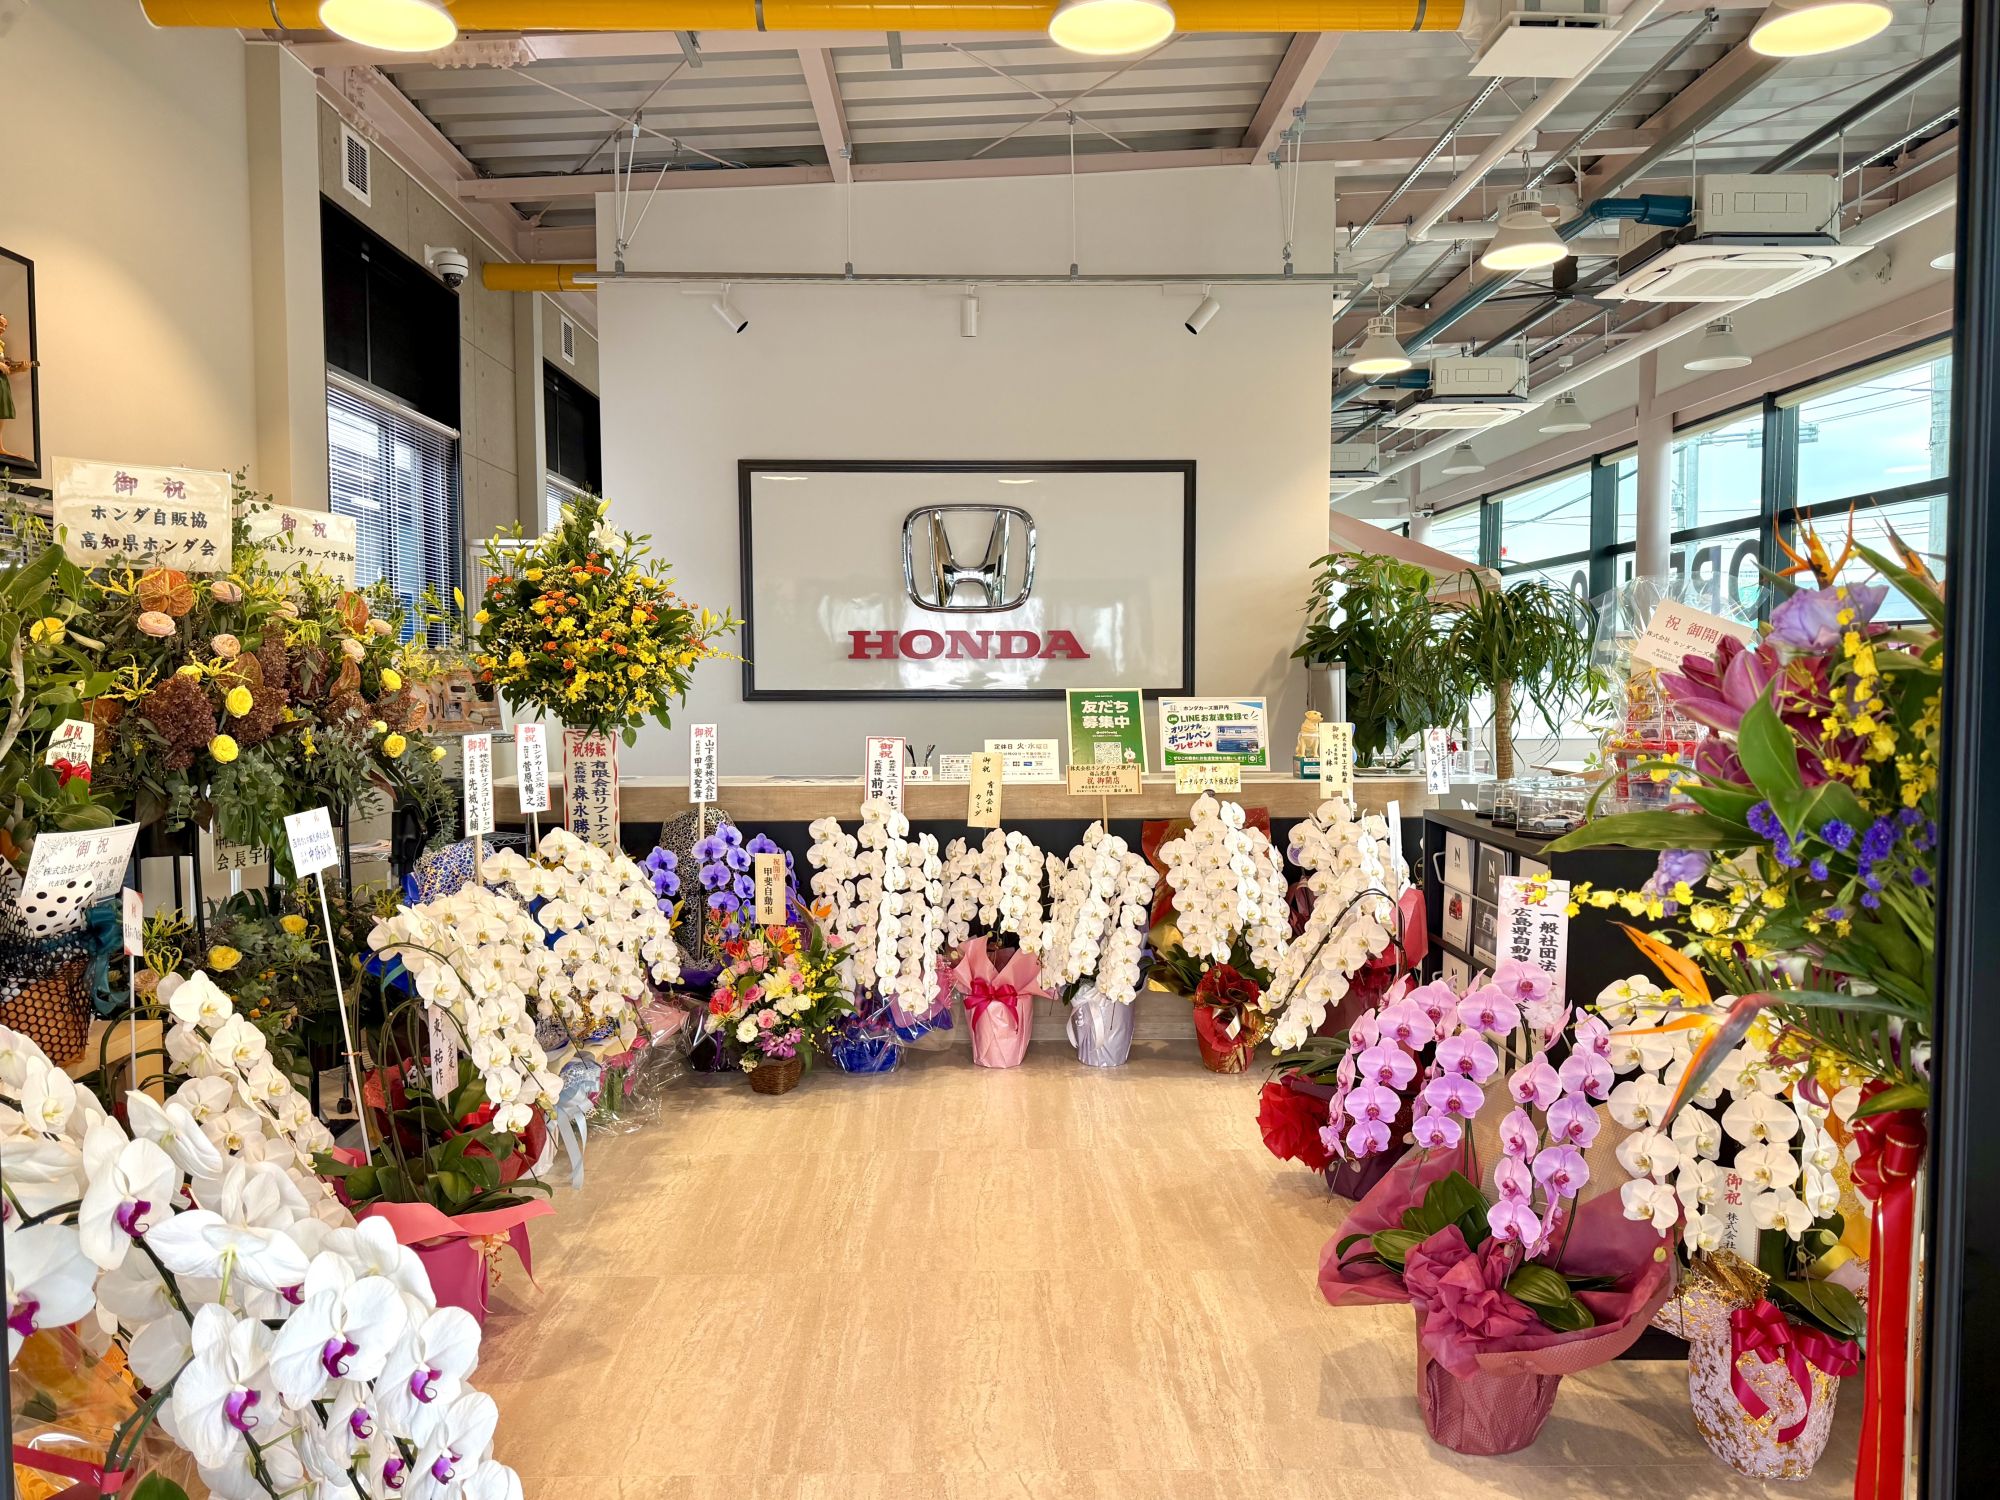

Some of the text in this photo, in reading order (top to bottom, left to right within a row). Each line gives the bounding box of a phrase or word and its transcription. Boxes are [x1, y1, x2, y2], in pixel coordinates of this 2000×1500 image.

[91, 505, 208, 529] ホンダ自販協
[80, 531, 217, 557] 高知県ホンダ会
[1686, 622, 1724, 646] 御開
[848, 629, 1091, 660] HONDA
[1081, 699, 1129, 714] 友だち
[1082, 715, 1130, 729] 募集中
[1170, 723, 1202, 733] オリジナル
[694, 727, 715, 738] 御祝
[467, 737, 488, 752] 御祝
[572, 742, 607, 758] 祝移転
[879, 743, 894, 758] 御祝
[1724, 1172, 1743, 1206] 御祝
[1722, 1211, 1739, 1250] 株式会社
